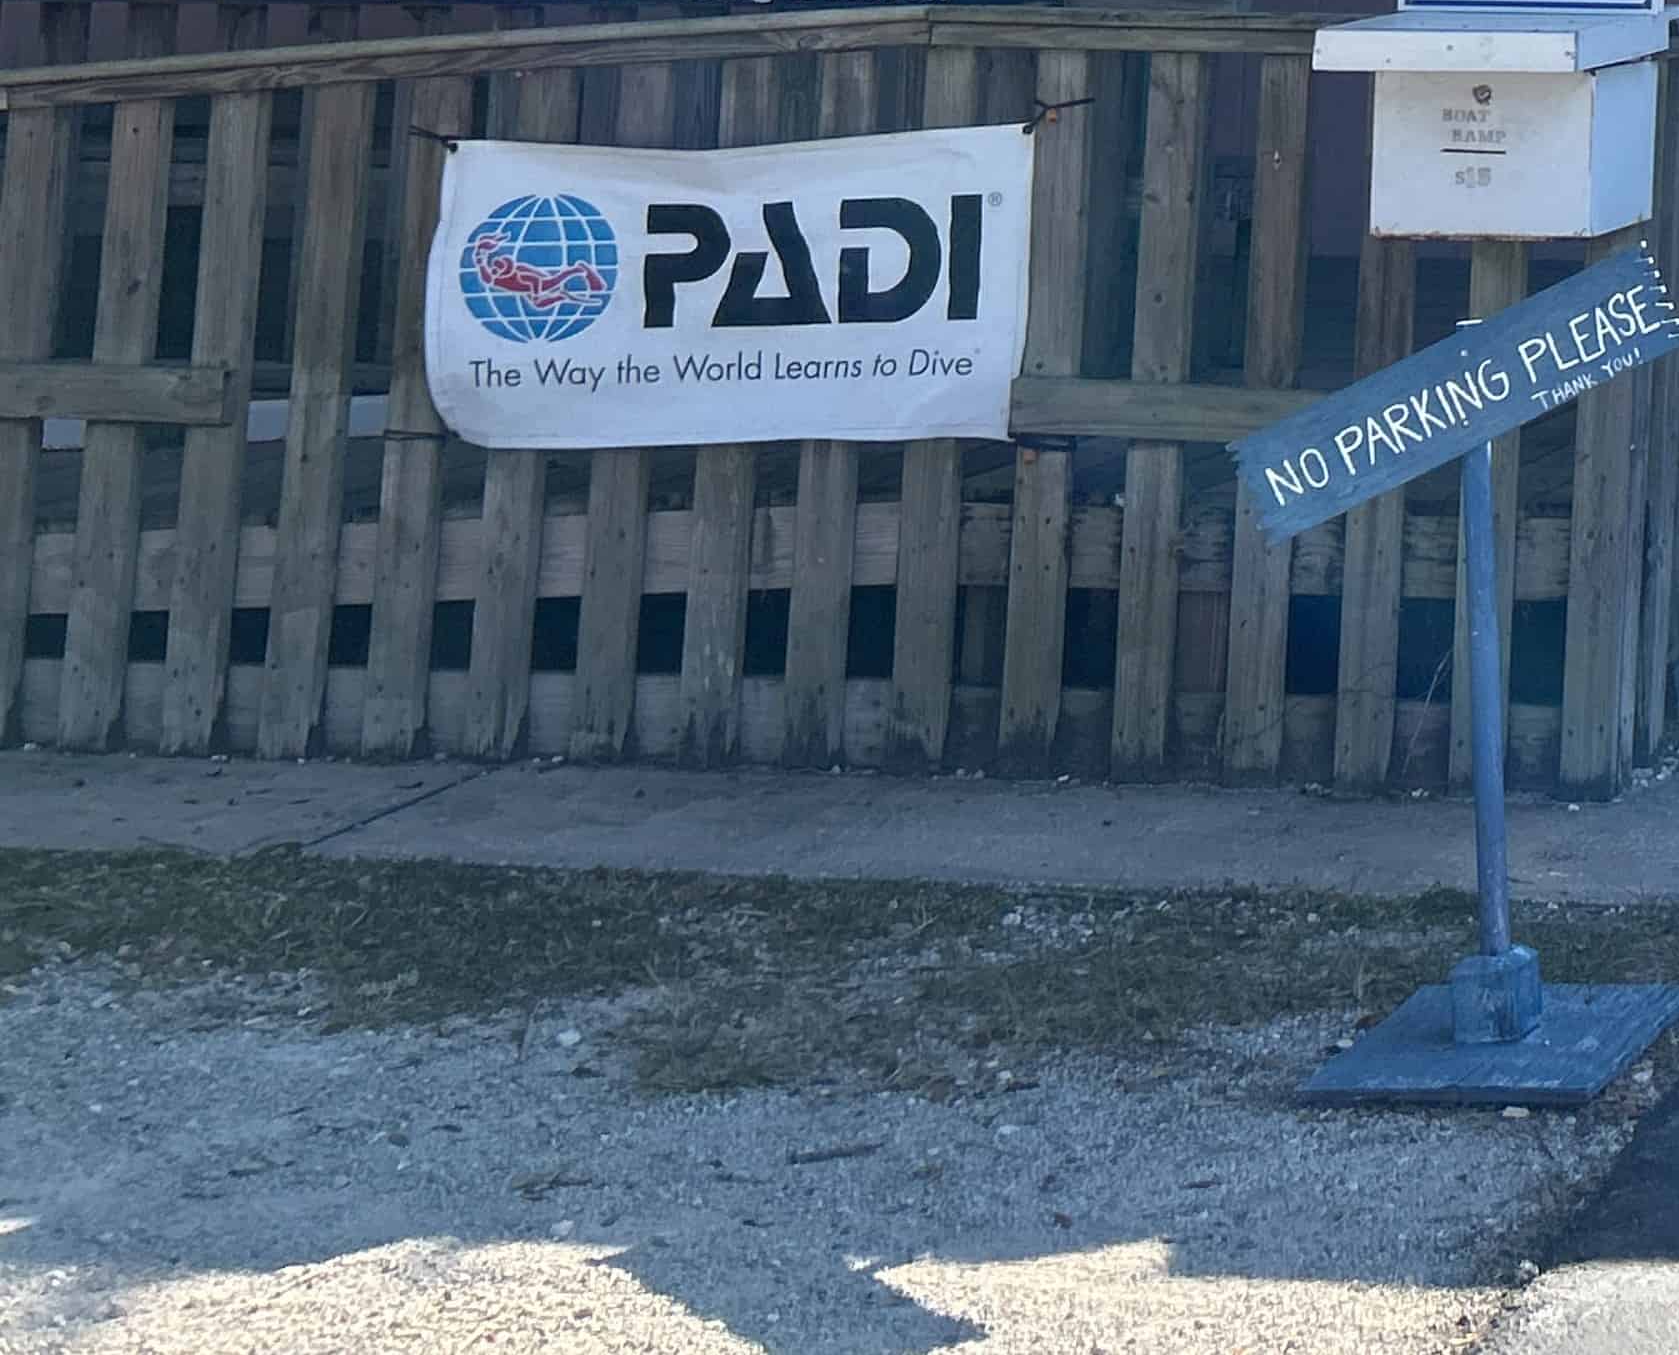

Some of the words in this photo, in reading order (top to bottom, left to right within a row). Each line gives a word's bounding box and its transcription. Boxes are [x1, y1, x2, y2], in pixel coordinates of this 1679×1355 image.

[1441, 107, 1492, 123] BOAT
[642, 192, 984, 330] PADI
[469, 360, 522, 390] The
[534, 358, 606, 394] Way
[616, 353, 661, 384] the
[673, 351, 763, 382] World
[775, 347, 862, 380] Learns
[873, 352, 898, 377] to
[909, 349, 974, 377] Dive
[1264, 448, 1331, 506] NO
[1334, 358, 1512, 477] PARKING
[1518, 284, 1662, 383] PLEASE
[1531, 372, 1598, 411] THANK
[1600, 347, 1643, 381] YOU!
